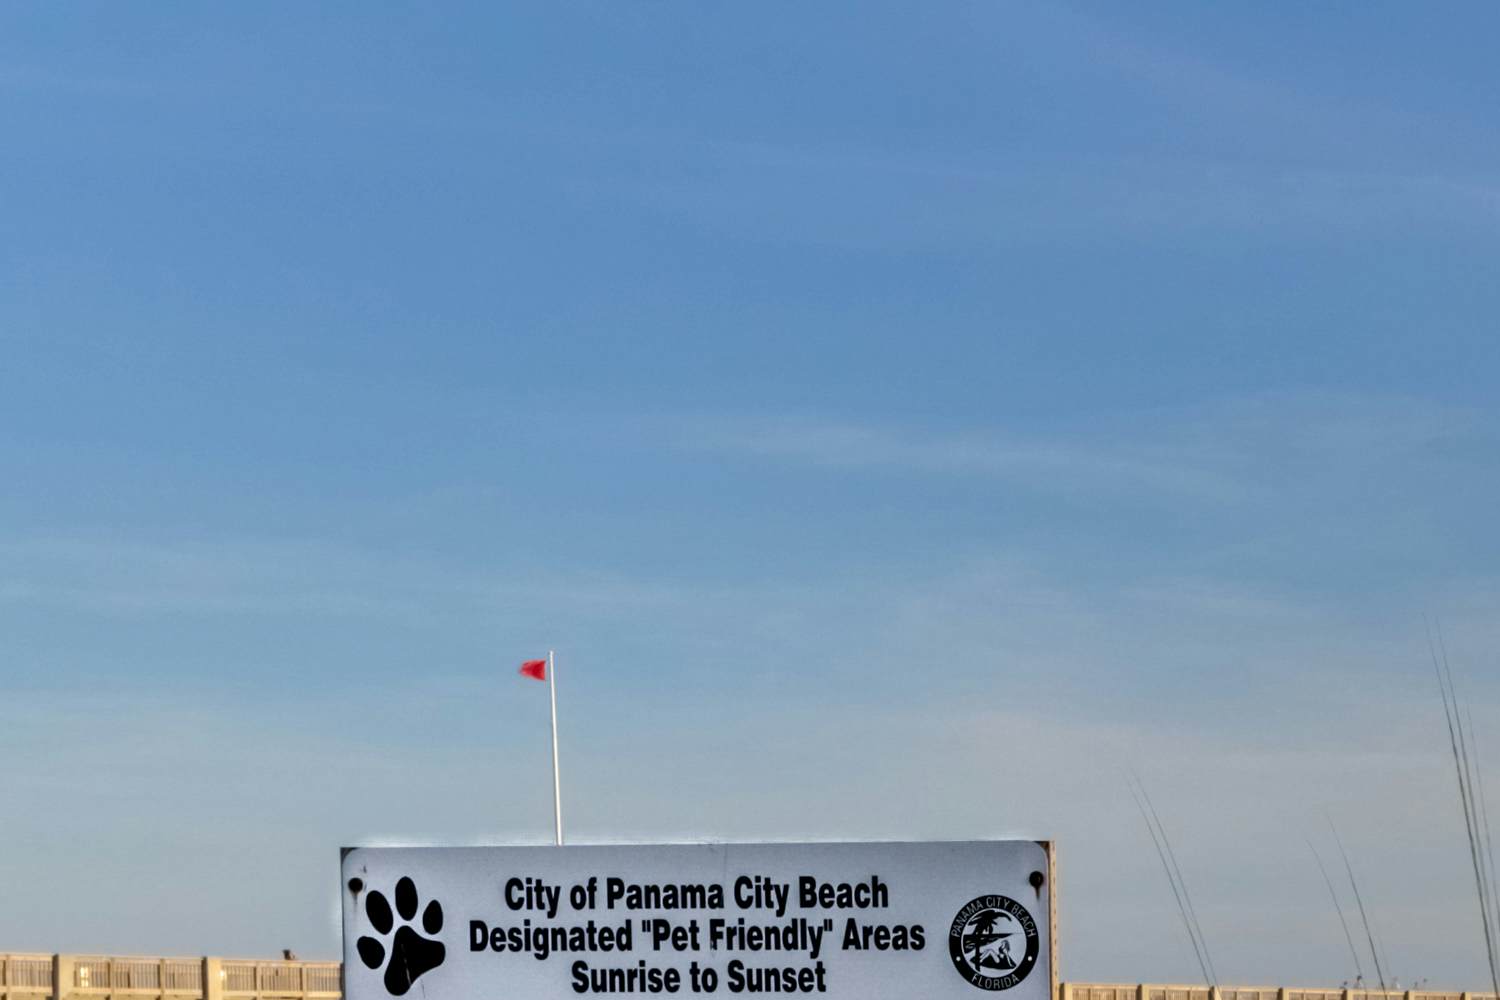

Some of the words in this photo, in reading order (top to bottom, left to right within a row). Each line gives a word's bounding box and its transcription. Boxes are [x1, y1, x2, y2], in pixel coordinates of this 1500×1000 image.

[505, 878, 560, 917] City
[570, 878, 597, 909] of
[607, 877, 724, 909] Panama
[734, 877, 789, 915] City
[799, 876, 888, 907] Beach
[951, 900, 984, 937] PANAMA
[986, 896, 1010, 909] CITY
[1010, 903, 1036, 938] BEACH
[470, 921, 632, 958] Designated
[642, 920, 700, 952] "Pet
[710, 920, 832, 958] Friendly"
[842, 919, 925, 951] Areas
[572, 961, 680, 992] Sunrise
[690, 960, 718, 991] to
[728, 960, 826, 991] Sunset
[971, 973, 1020, 989] FLORIDA
